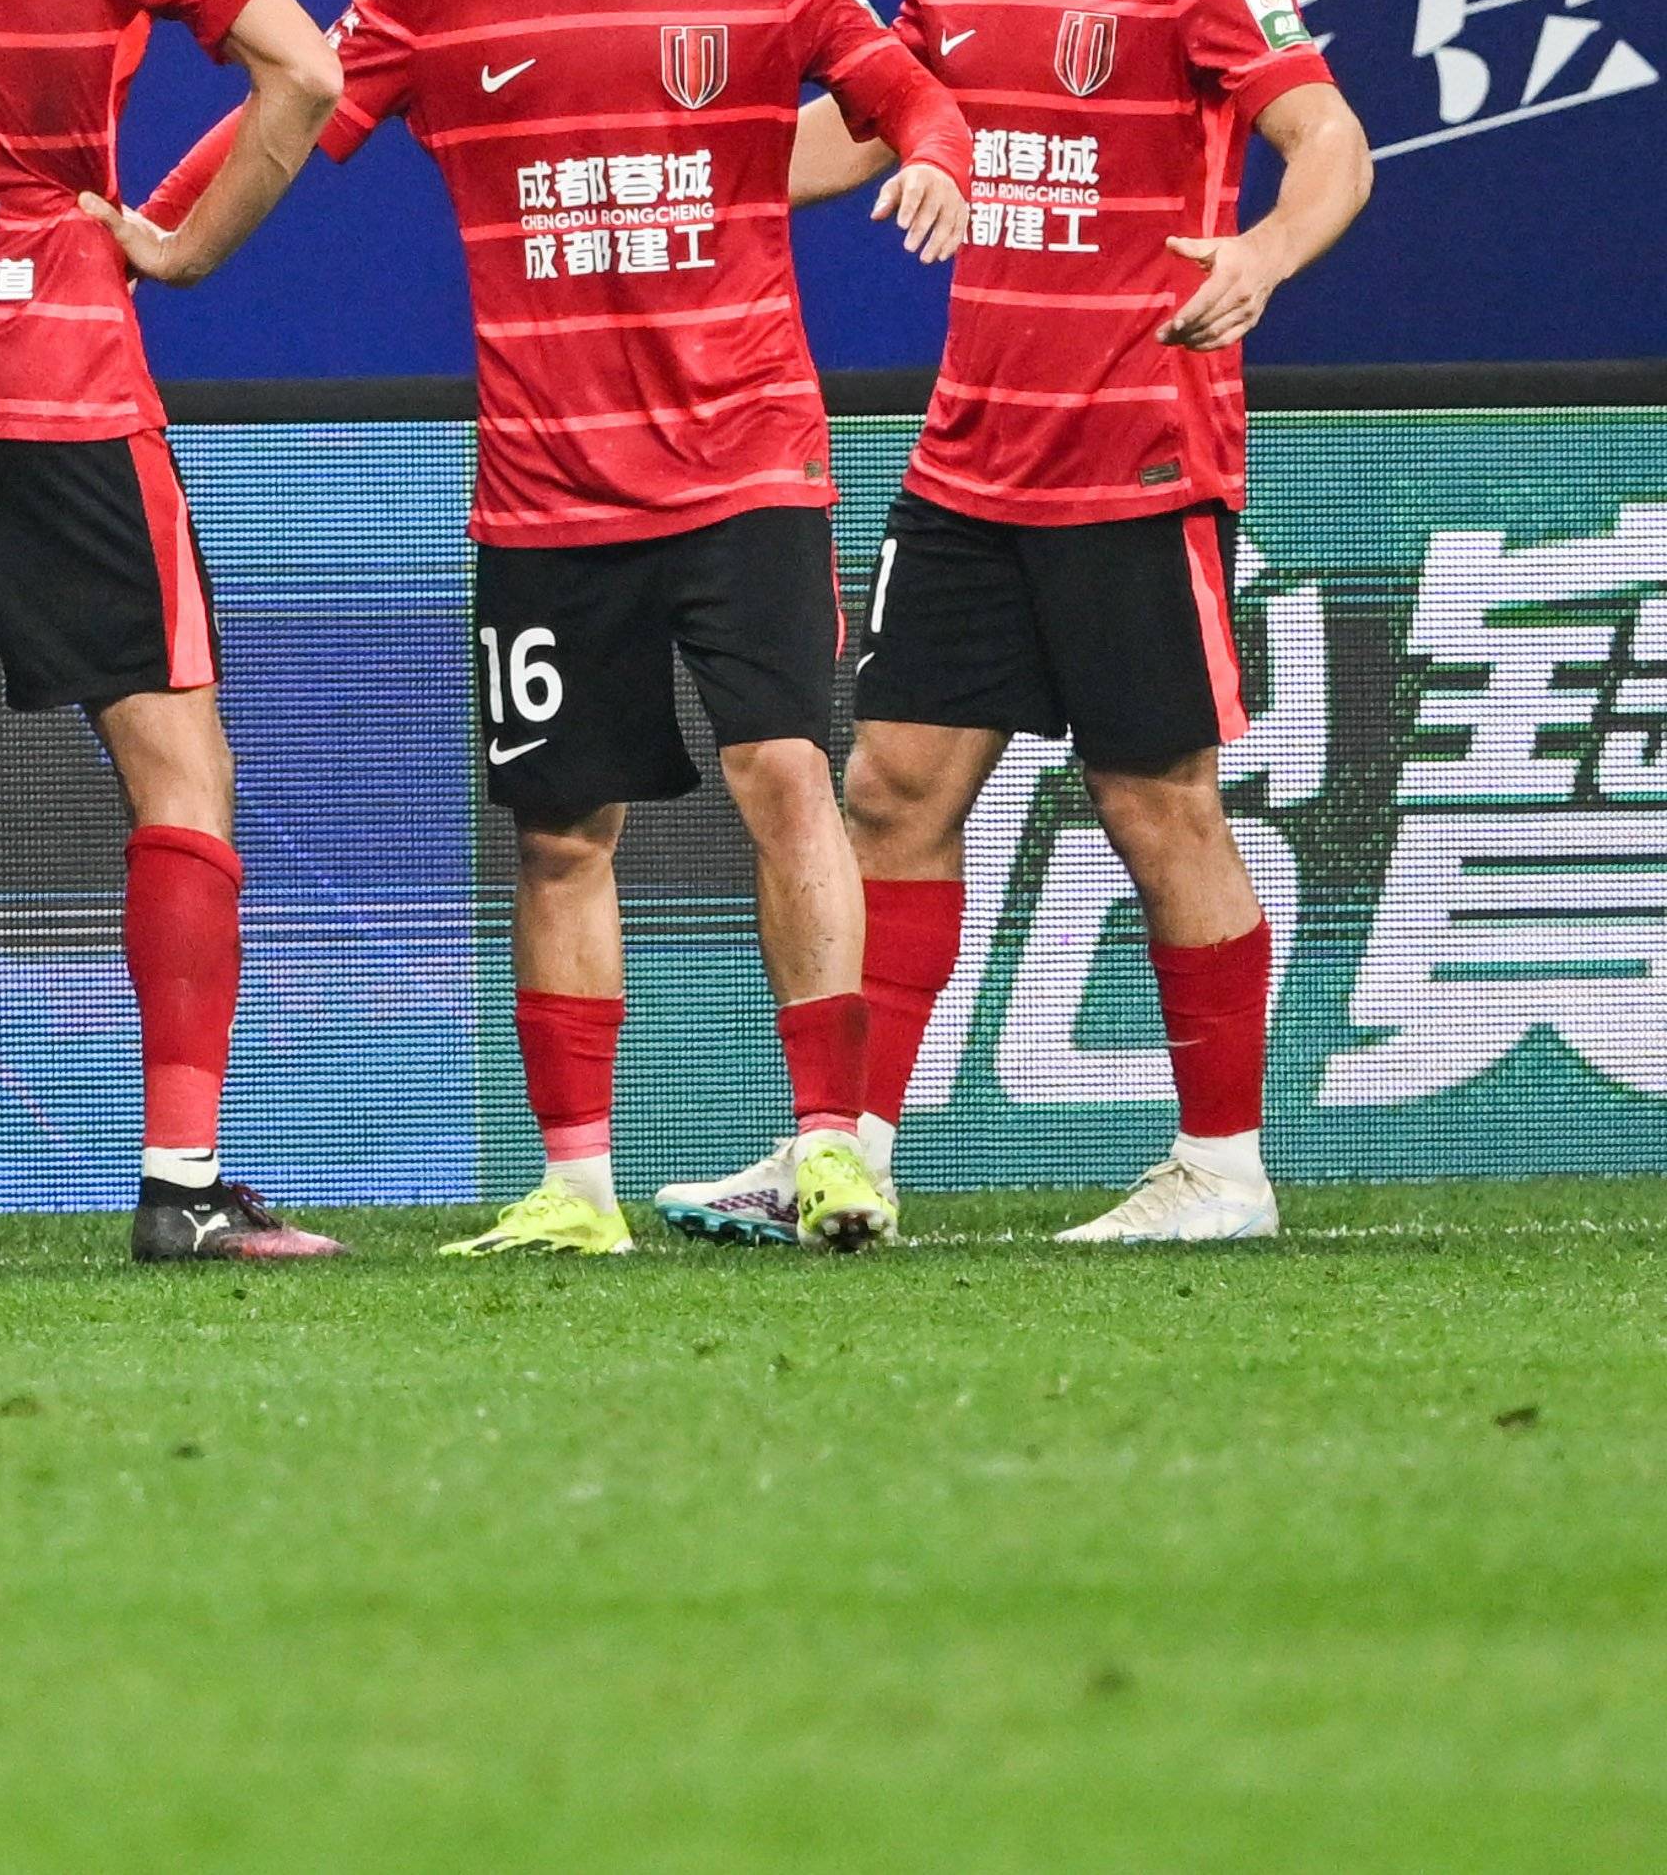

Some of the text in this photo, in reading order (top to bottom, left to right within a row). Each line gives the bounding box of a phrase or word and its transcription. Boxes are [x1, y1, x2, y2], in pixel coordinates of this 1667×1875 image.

[517, 148, 714, 210] 成都蓉城
[969, 128, 1100, 185] 都蓉城
[520, 202, 716, 231] CHENGDU RONGCHENG
[998, 183, 1100, 206] RONGCHENG
[524, 222, 716, 280] 成都建工
[964, 202, 1100, 253] 都建工
[478, 626, 564, 724] 16
